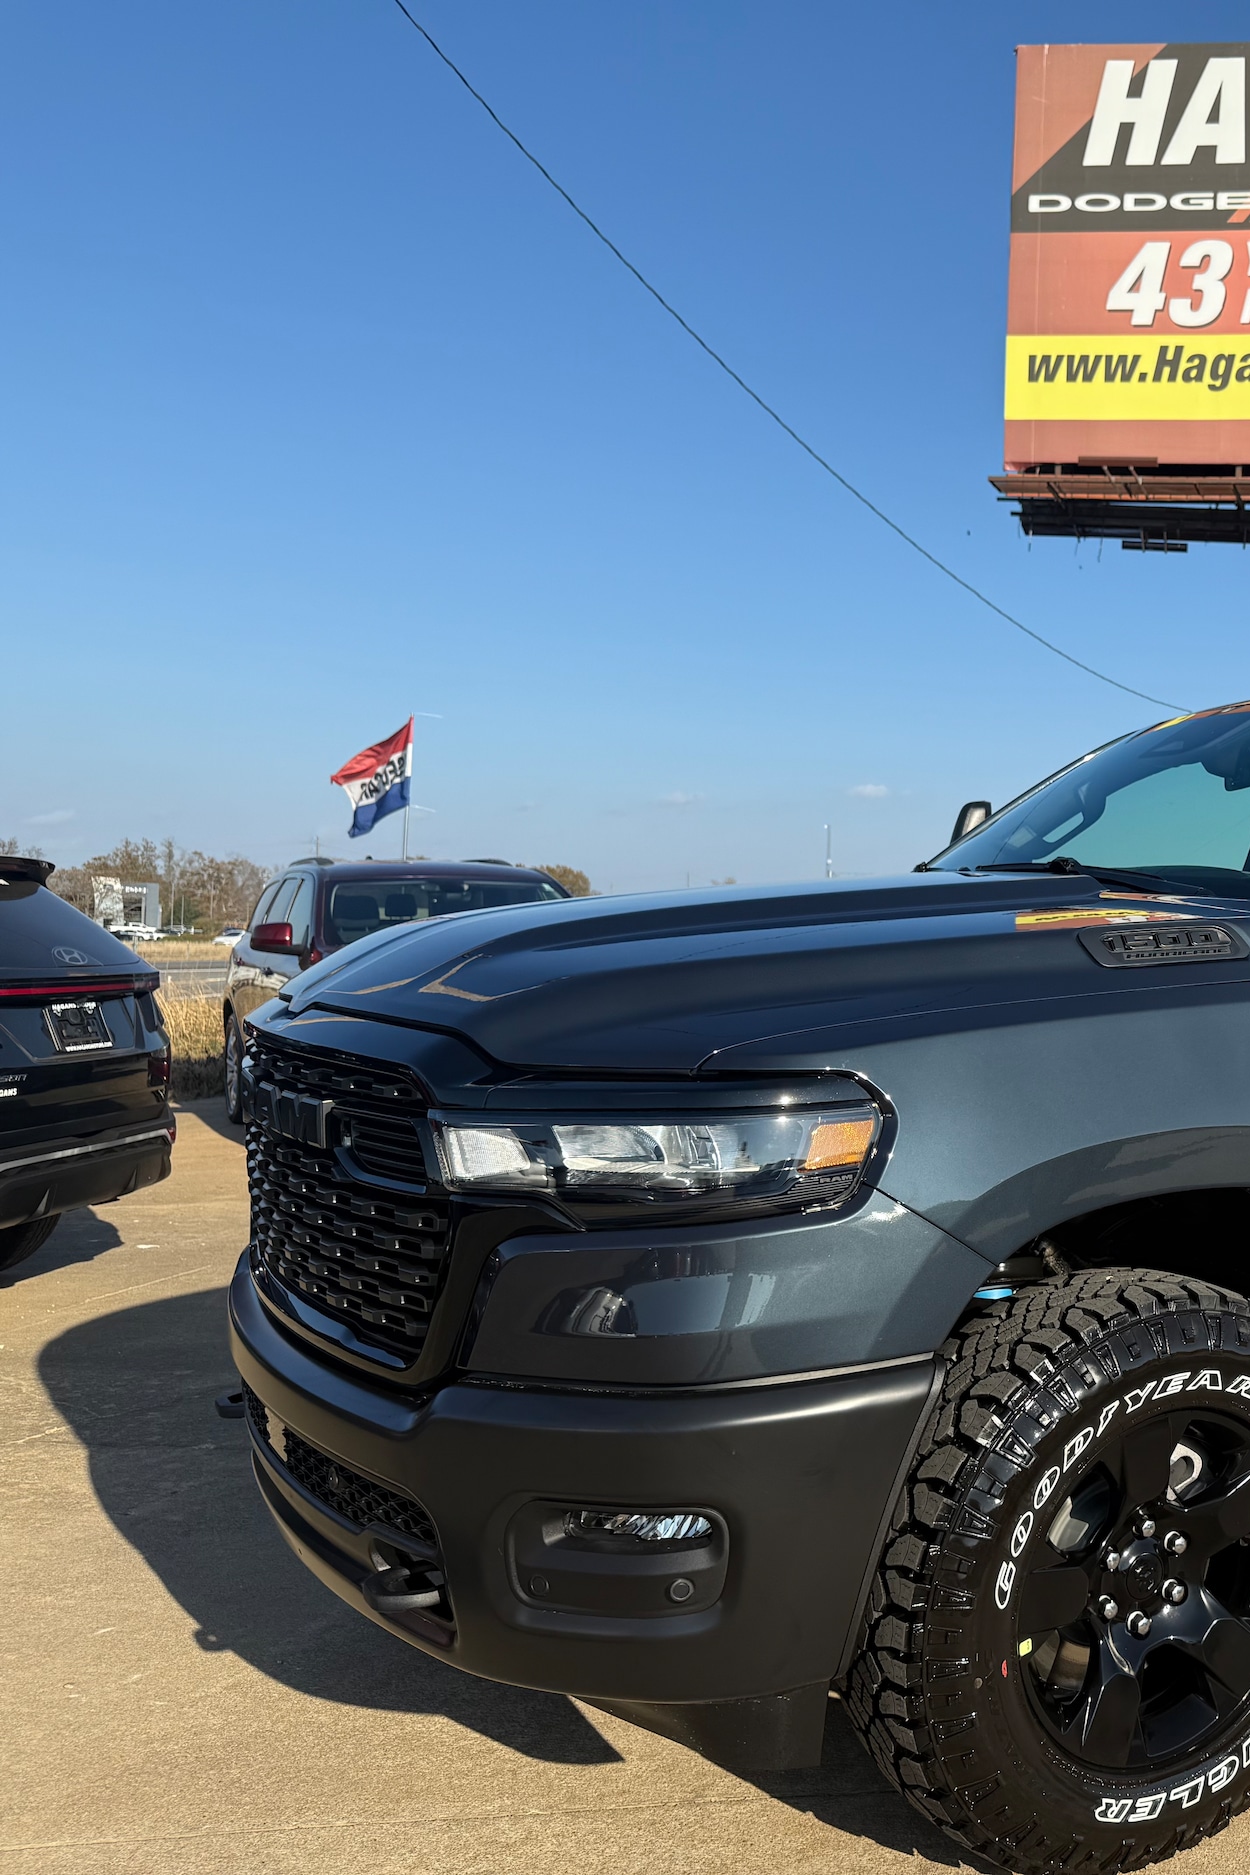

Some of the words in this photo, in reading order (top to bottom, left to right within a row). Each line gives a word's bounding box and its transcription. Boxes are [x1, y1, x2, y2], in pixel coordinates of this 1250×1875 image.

[1105, 239, 1235, 328] 43
[1102, 932, 1219, 952] 1500
[819, 1174, 854, 1184] RAM
